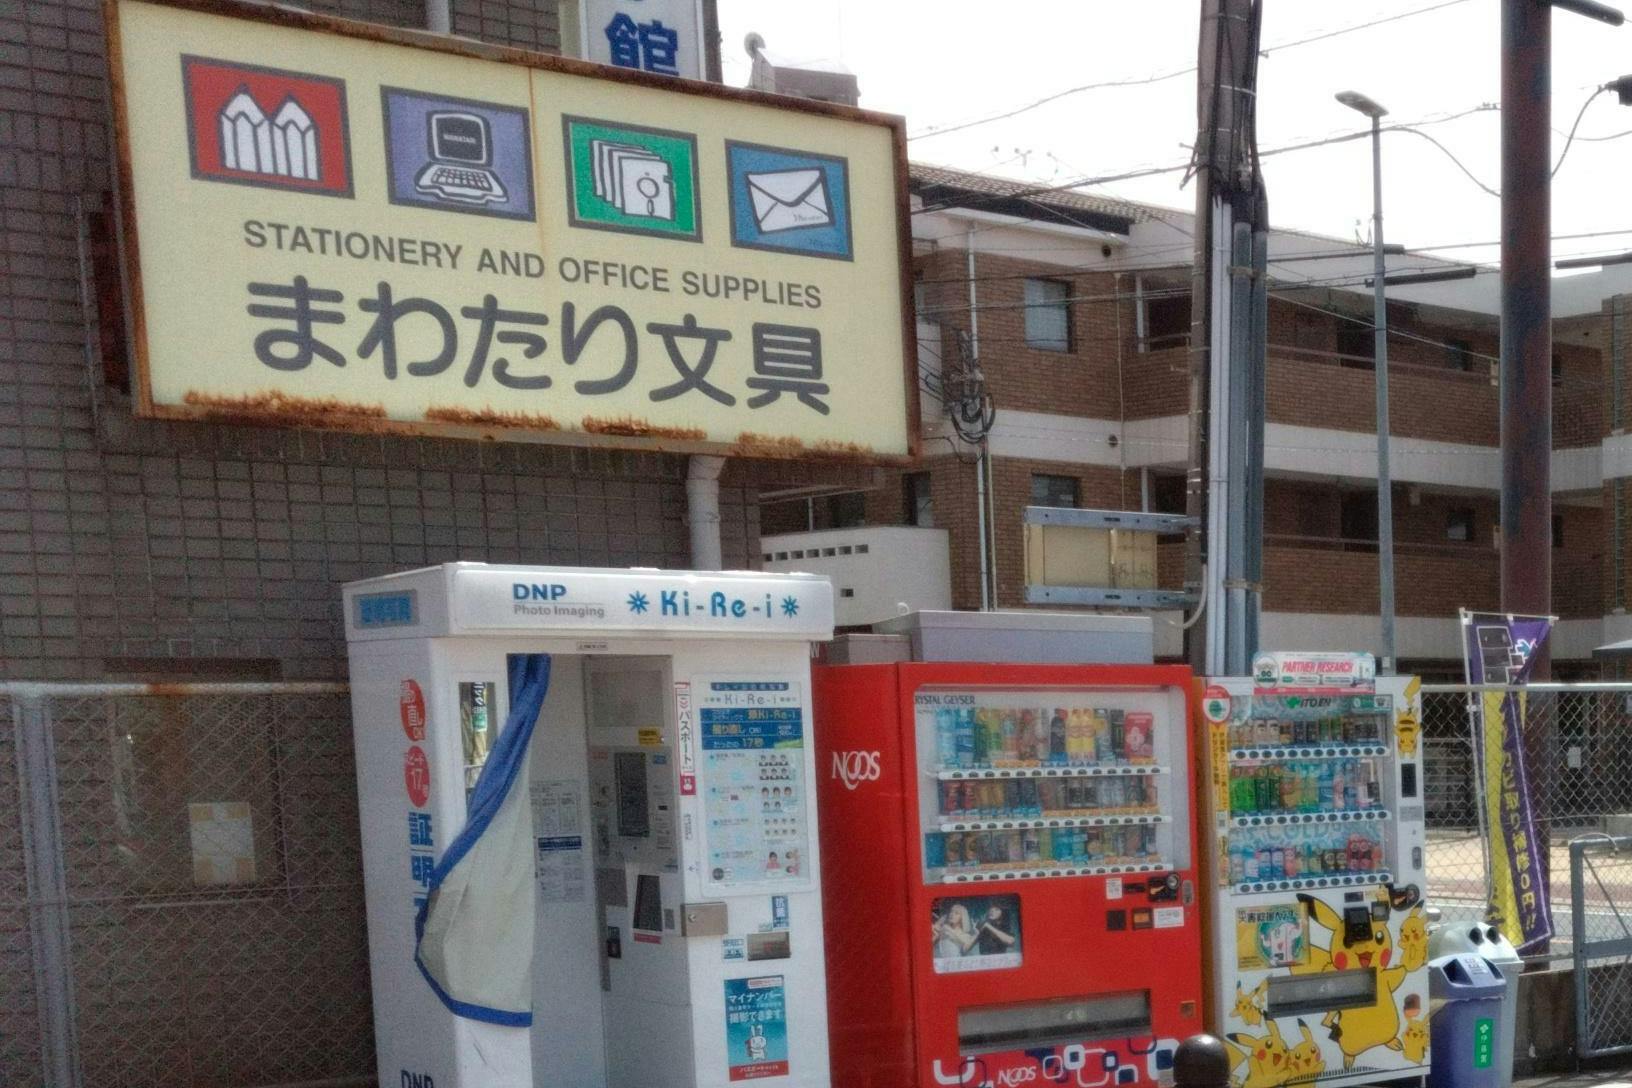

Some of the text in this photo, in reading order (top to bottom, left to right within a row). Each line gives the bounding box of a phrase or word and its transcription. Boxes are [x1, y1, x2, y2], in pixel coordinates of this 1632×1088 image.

[243, 219, 822, 309] STATIONERY AND OFFICE SUPPLIES
[246, 274, 831, 416] まわたり文具
[512, 583, 772, 619] DNP Ki-Re-i
[513, 604, 605, 618] Photo Imaging
